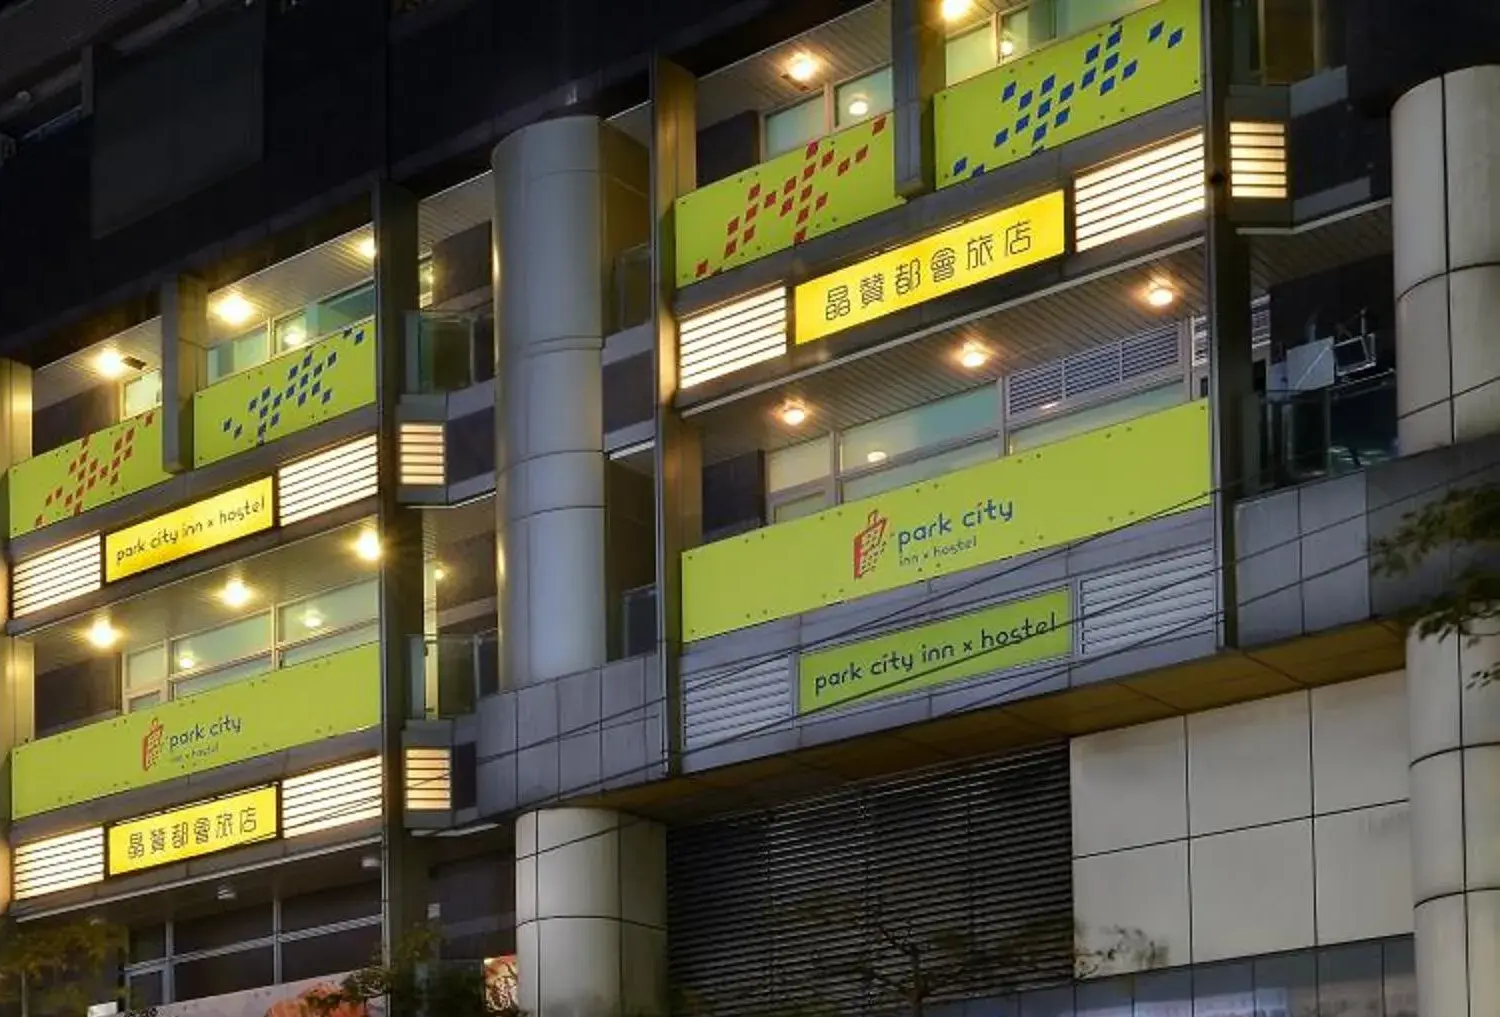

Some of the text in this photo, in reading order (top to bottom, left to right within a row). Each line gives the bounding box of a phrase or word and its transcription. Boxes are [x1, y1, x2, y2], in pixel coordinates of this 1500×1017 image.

[825, 219, 1032, 321] 晶贊都會旅店
[115, 537, 147, 566] park
[150, 527, 179, 550] city
[182, 521, 203, 537] inn
[218, 494, 265, 526] hostel
[897, 499, 1013, 553] park city
[900, 554, 919, 566] inn
[933, 535, 978, 557] hostel
[814, 661, 863, 697] park
[869, 651, 915, 676] city
[921, 643, 955, 663] inn
[980, 612, 1056, 650] hostel
[169, 714, 242, 752] park city
